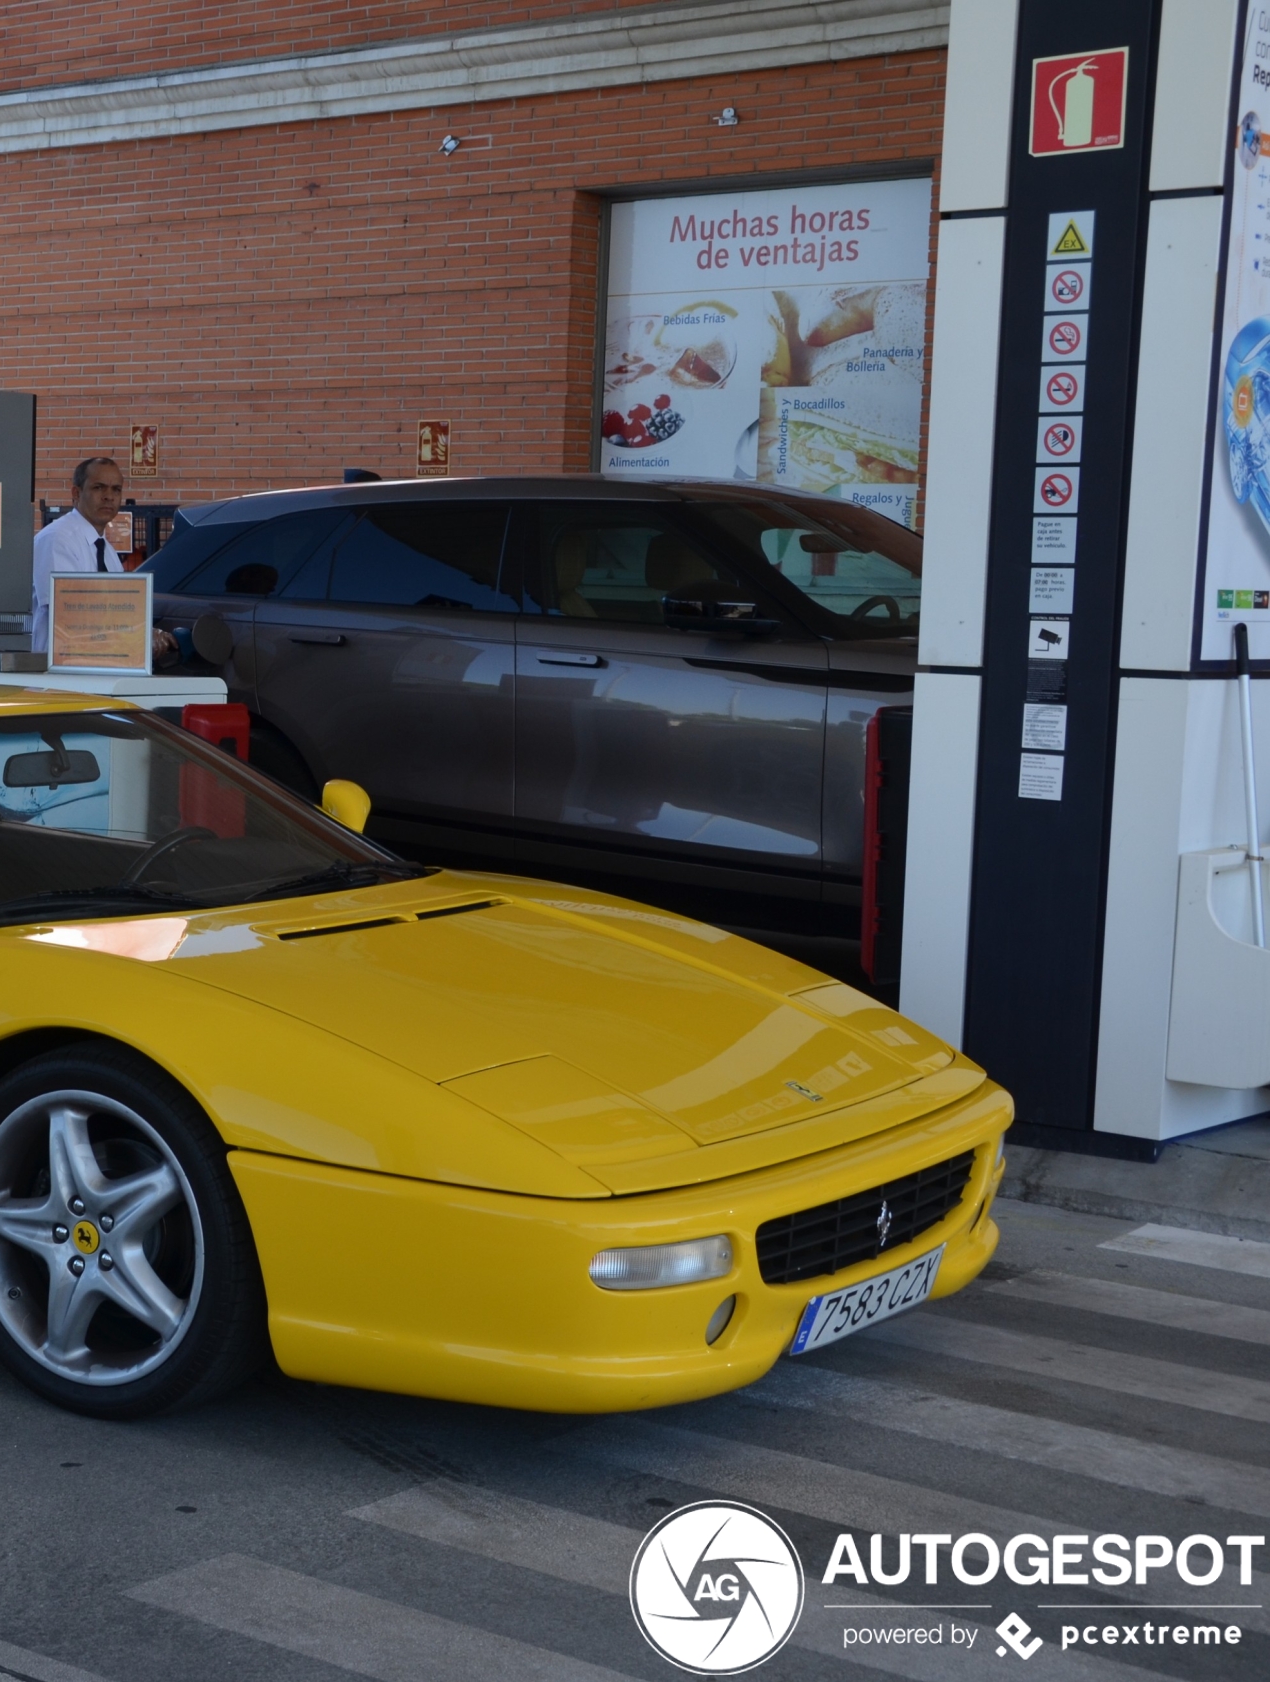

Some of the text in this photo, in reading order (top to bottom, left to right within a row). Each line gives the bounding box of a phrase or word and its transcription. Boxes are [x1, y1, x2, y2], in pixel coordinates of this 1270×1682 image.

[669, 204, 871, 243] Muchas horas
[1063, 240, 1077, 249] EX
[696, 235, 859, 272] de ventajas
[663, 313, 726, 326] Bebidas Frías
[917, 348, 923, 359] y
[793, 398, 845, 410] Bocadillos
[777, 408, 789, 474] Sandwiches
[608, 456, 670, 468] Alimentación
[852, 492, 902, 507] Regalos y
[901, 495, 915, 529] Jugue
[814, 1253, 939, 1341] 7583 CZX
[797, 1330, 808, 1344] E
